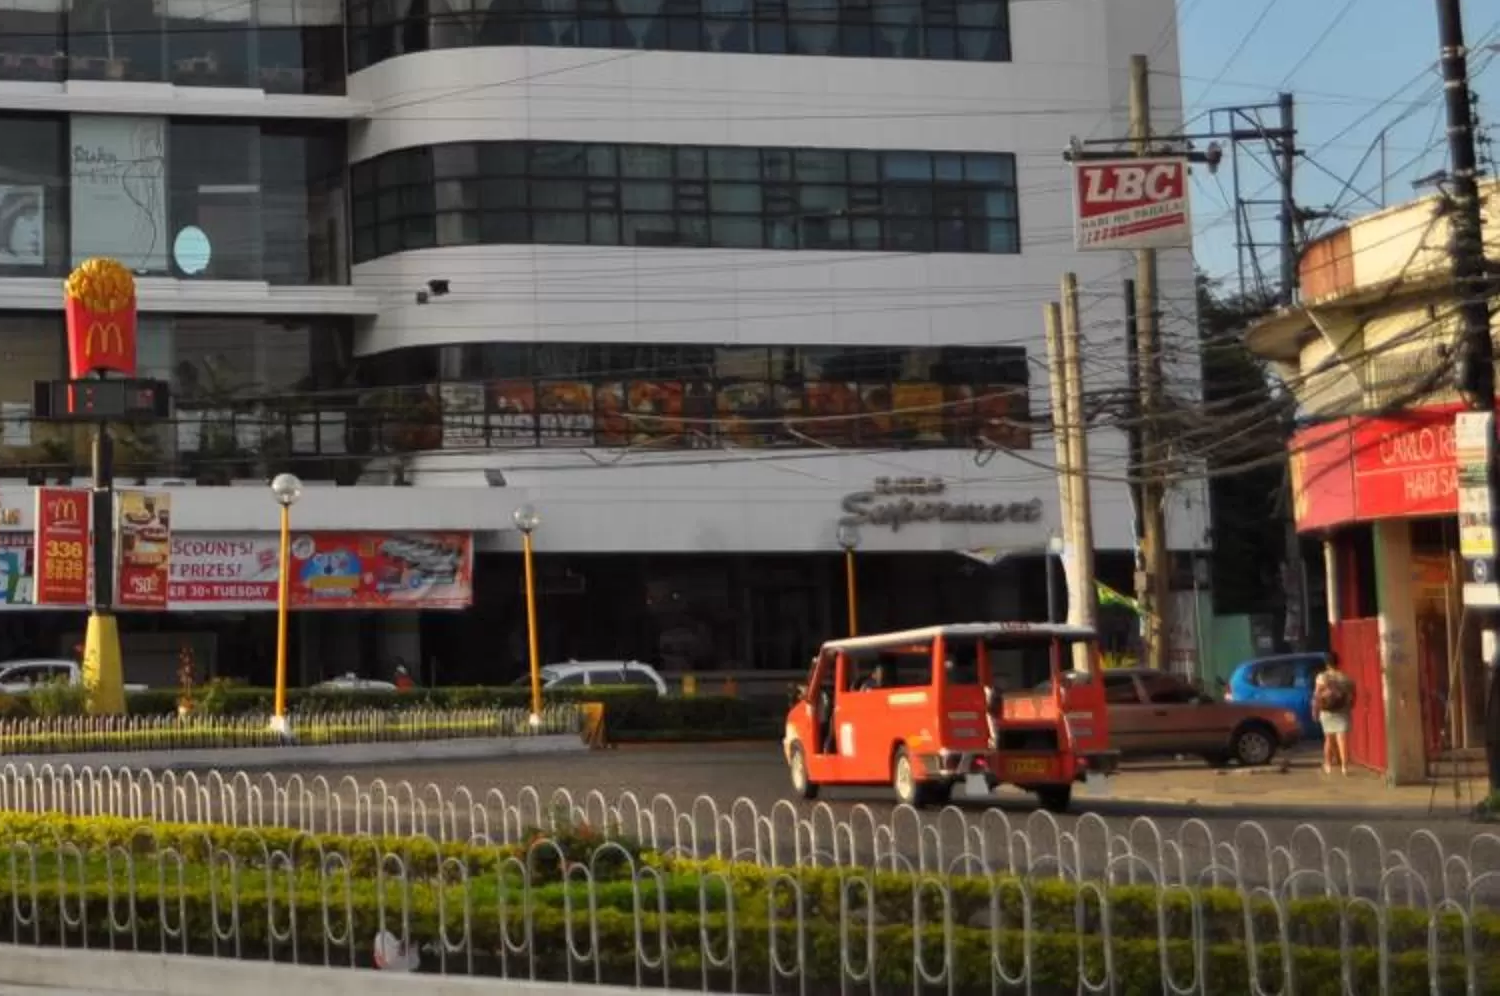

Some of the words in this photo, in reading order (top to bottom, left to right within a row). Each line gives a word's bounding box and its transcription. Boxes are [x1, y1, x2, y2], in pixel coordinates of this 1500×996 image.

[1084, 164, 1176, 203] LBC
[1403, 470, 1438, 500] HAIR
[170, 538, 254, 557] SCOUNTS!
[180, 563, 243, 578] PRIZES!
[213, 585, 270, 598] TUESDAY
